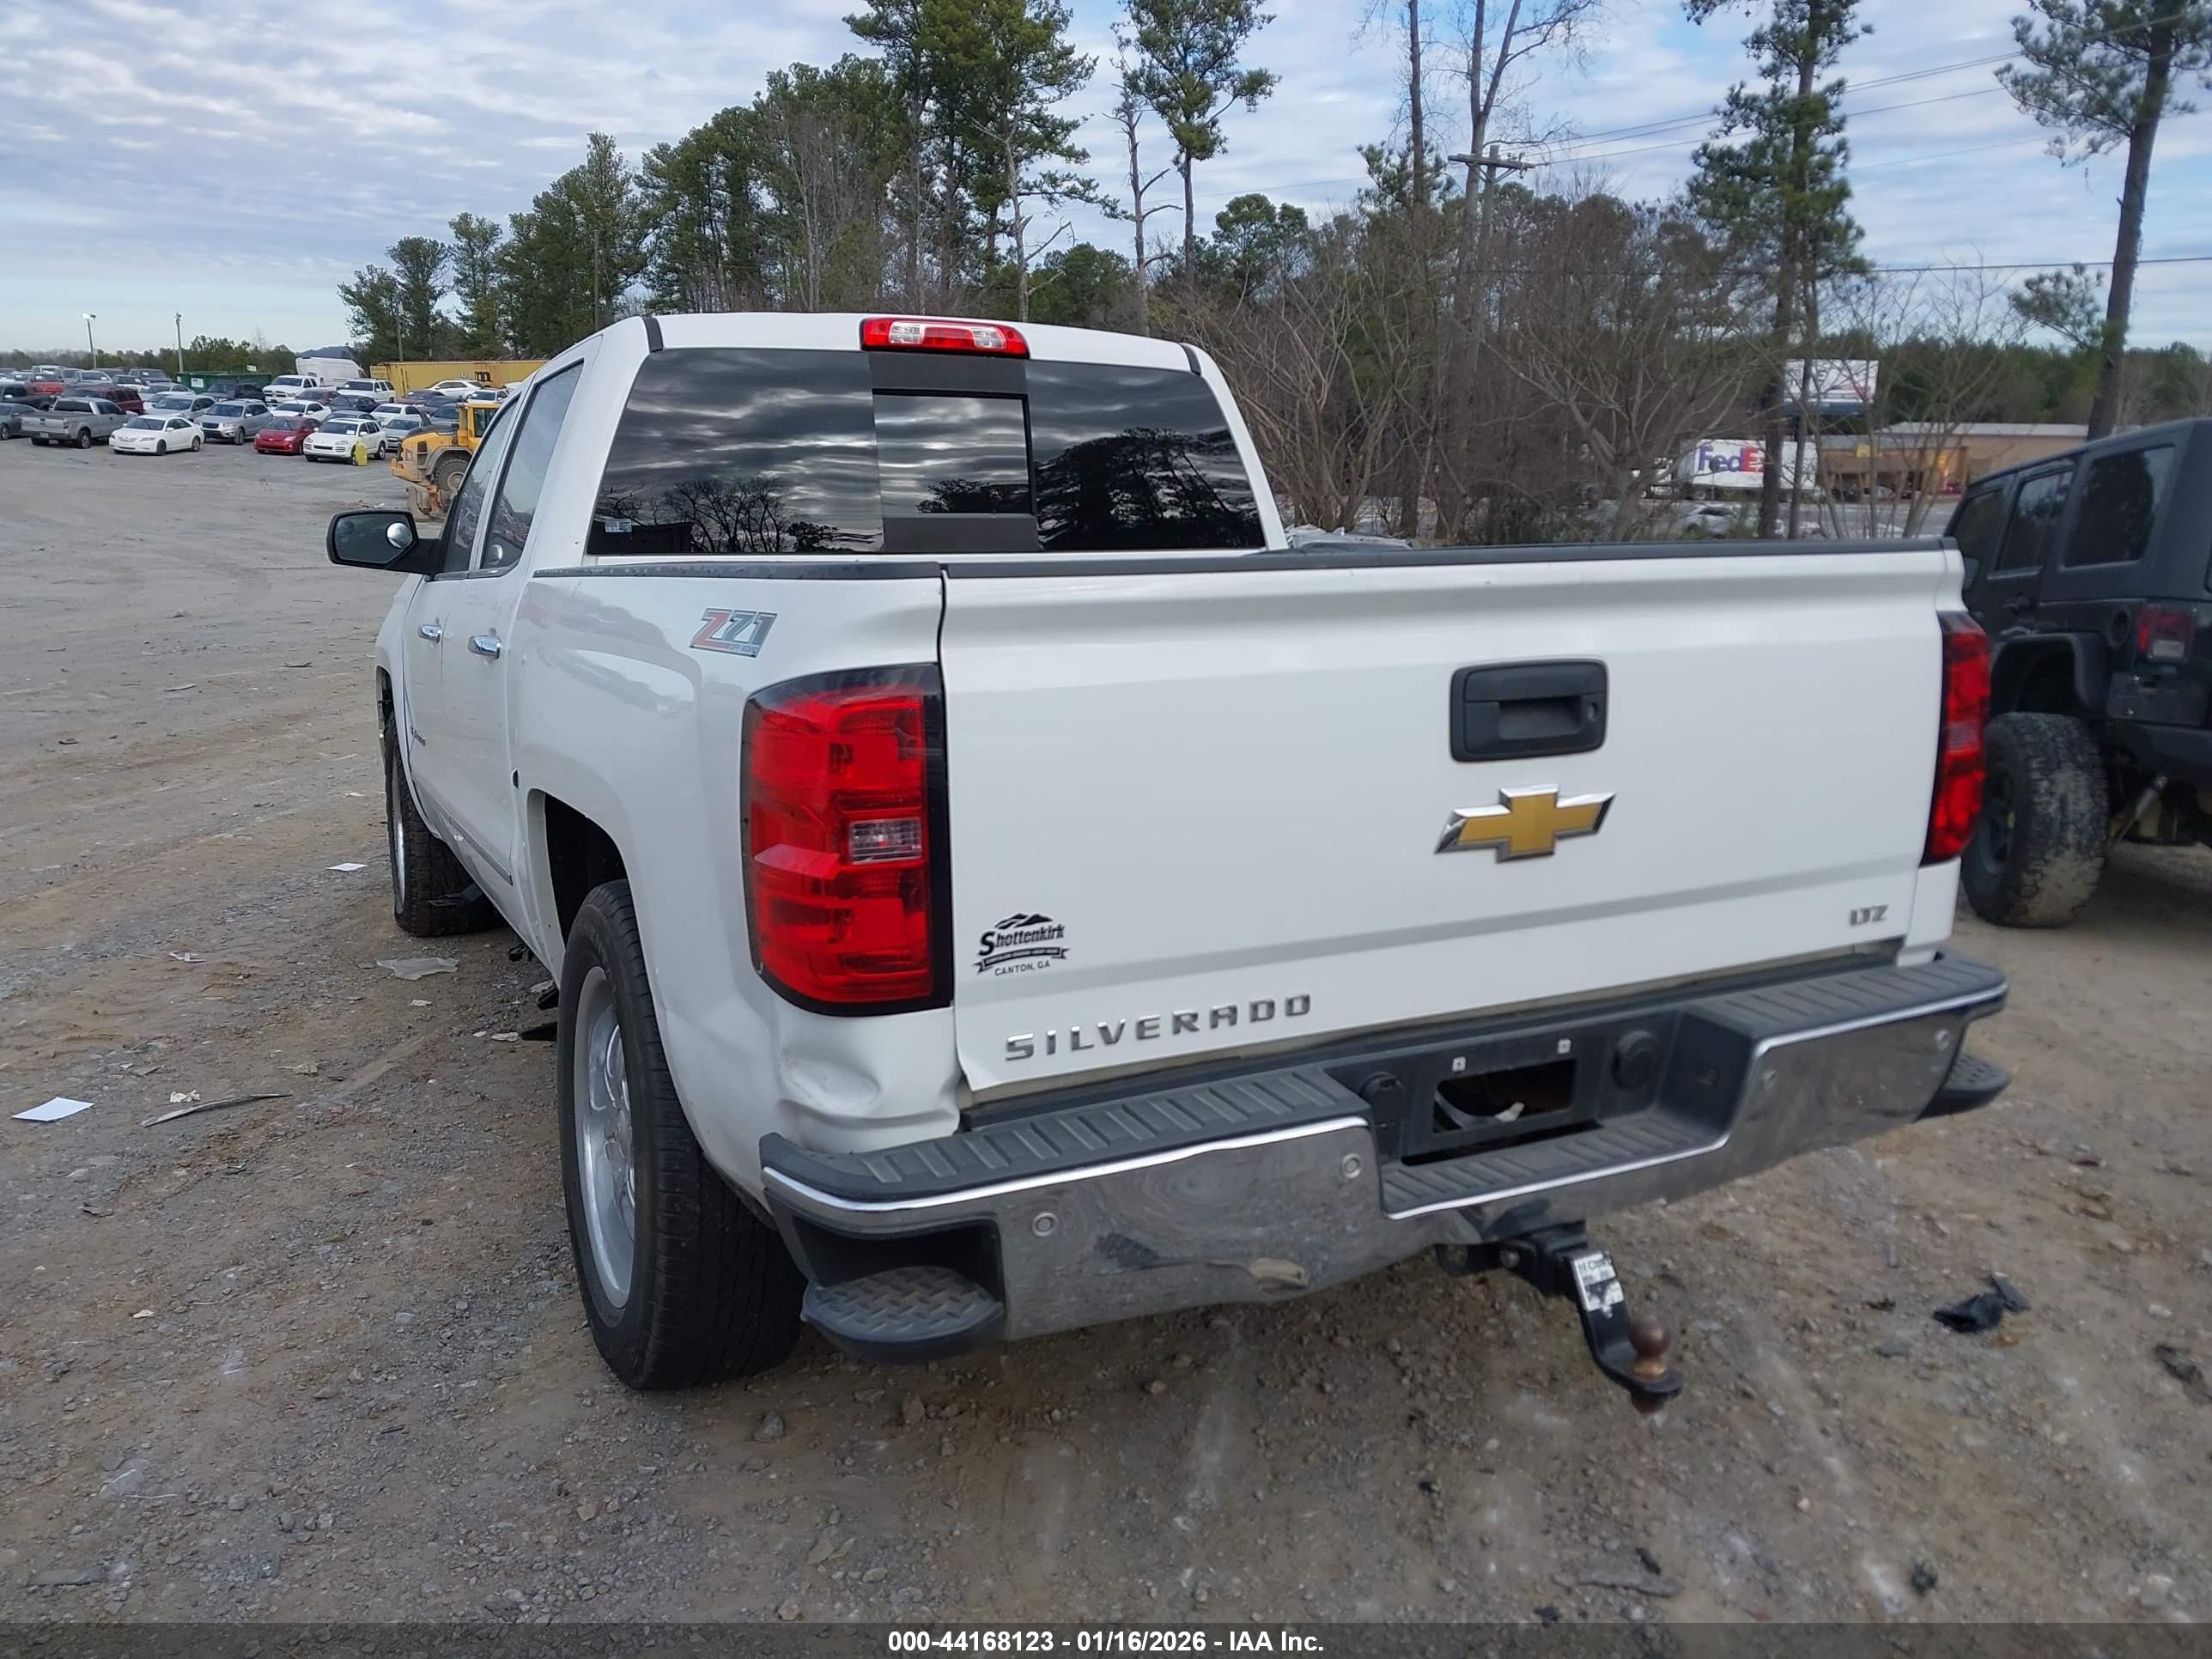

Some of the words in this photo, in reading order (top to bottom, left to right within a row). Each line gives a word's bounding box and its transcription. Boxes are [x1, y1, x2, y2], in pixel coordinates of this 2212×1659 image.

[1698, 445, 1765, 473] FedE
[690, 607, 778, 658] Z71
[1850, 904, 1889, 927] LTZ
[978, 924, 1066, 956] Shottenkirk
[994, 963, 1036, 976] CANTON,
[1037, 960, 1051, 969] GA
[1006, 994, 1311, 1062] SILVERADO
